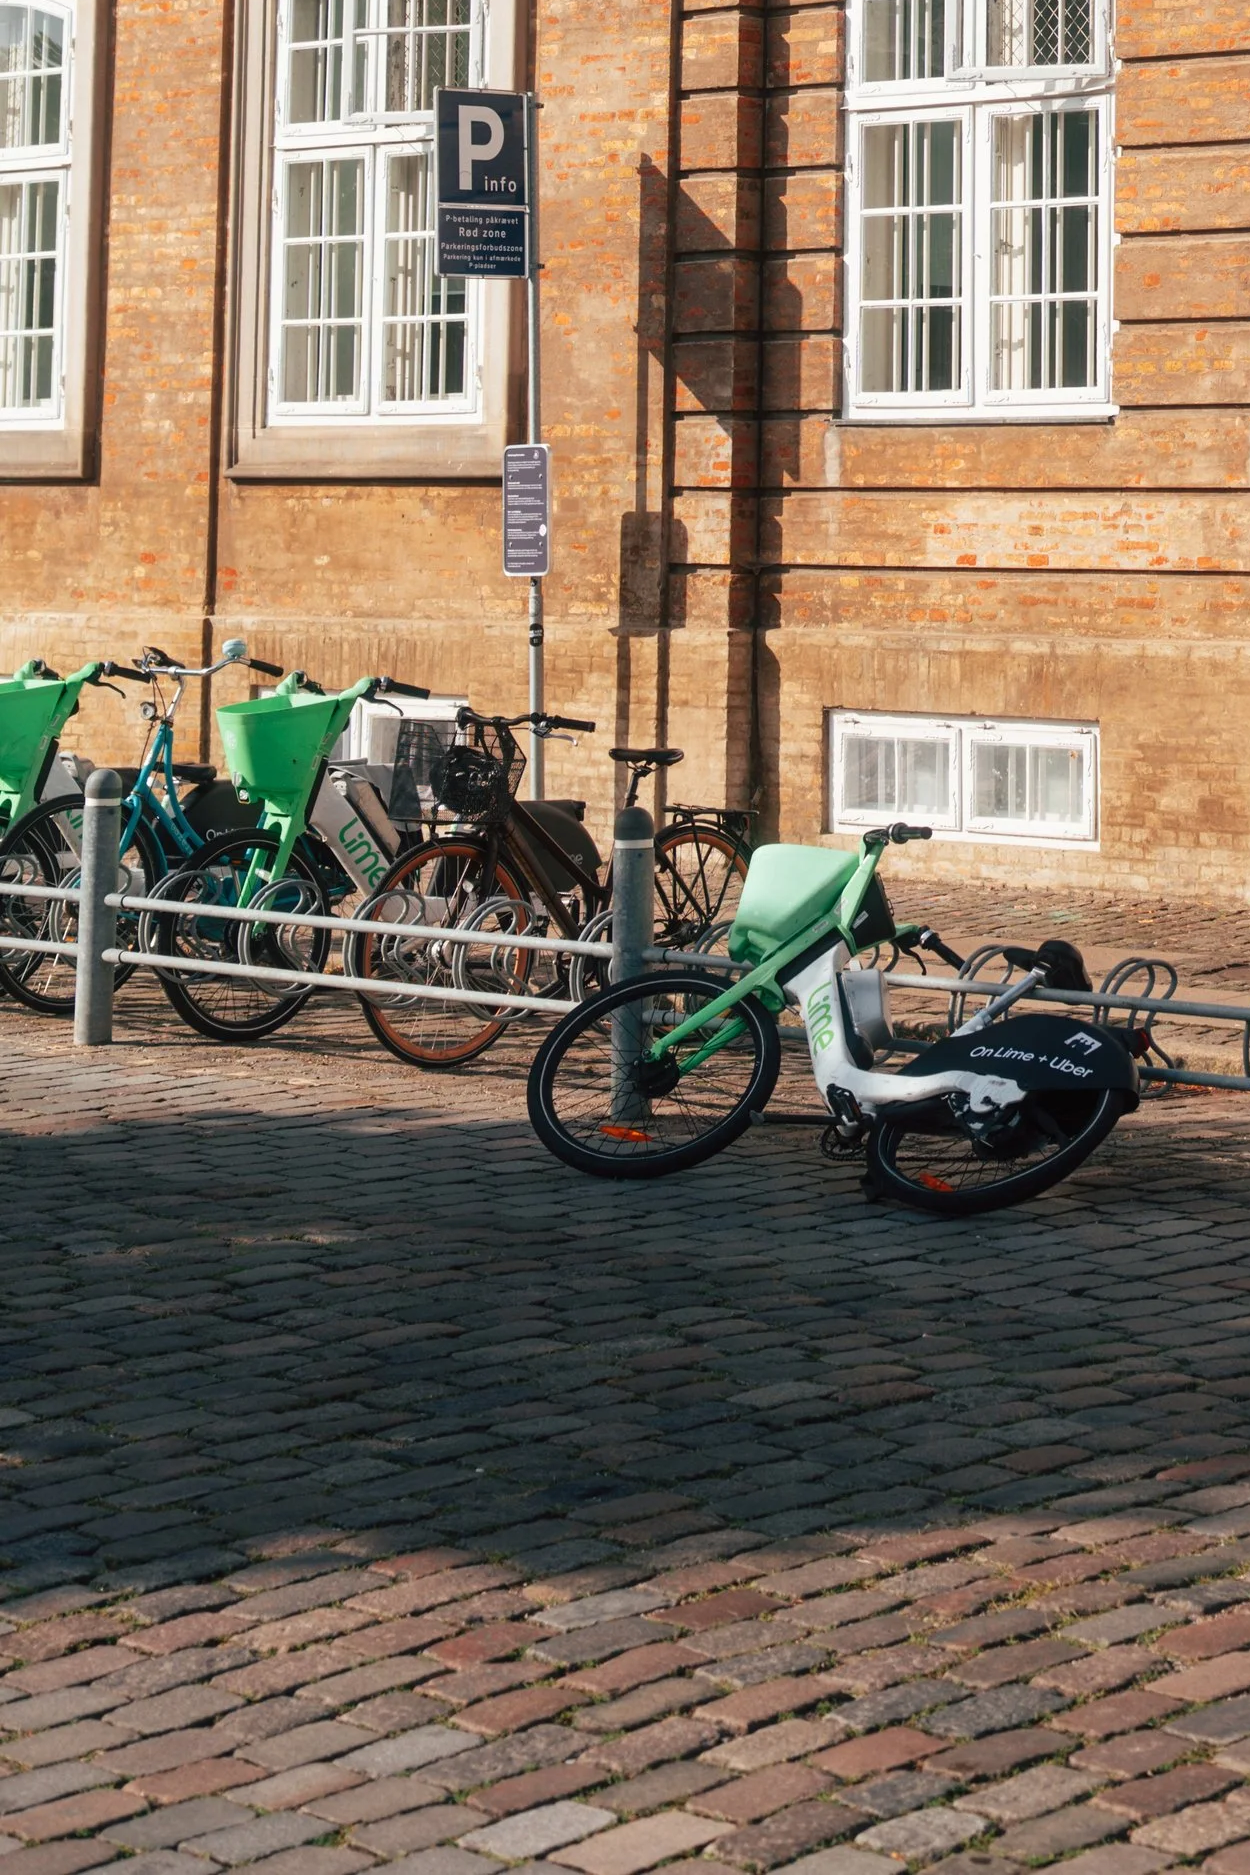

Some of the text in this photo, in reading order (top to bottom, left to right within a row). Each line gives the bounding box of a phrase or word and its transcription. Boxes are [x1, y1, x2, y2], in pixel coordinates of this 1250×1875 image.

[458, 105, 517, 192] P info
[445, 214, 519, 225] P-betaling påkrævet
[458, 227, 507, 238] Rød zone
[440, 242, 523, 252] Parkeringsforbudszone
[443, 253, 471, 261] Parkering
[338, 816, 387, 889] Lime
[807, 980, 834, 1057] Lime
[970, 1046, 994, 1057] On
[993, 1046, 1035, 1062] Lime
[1049, 1056, 1094, 1078] Uber
